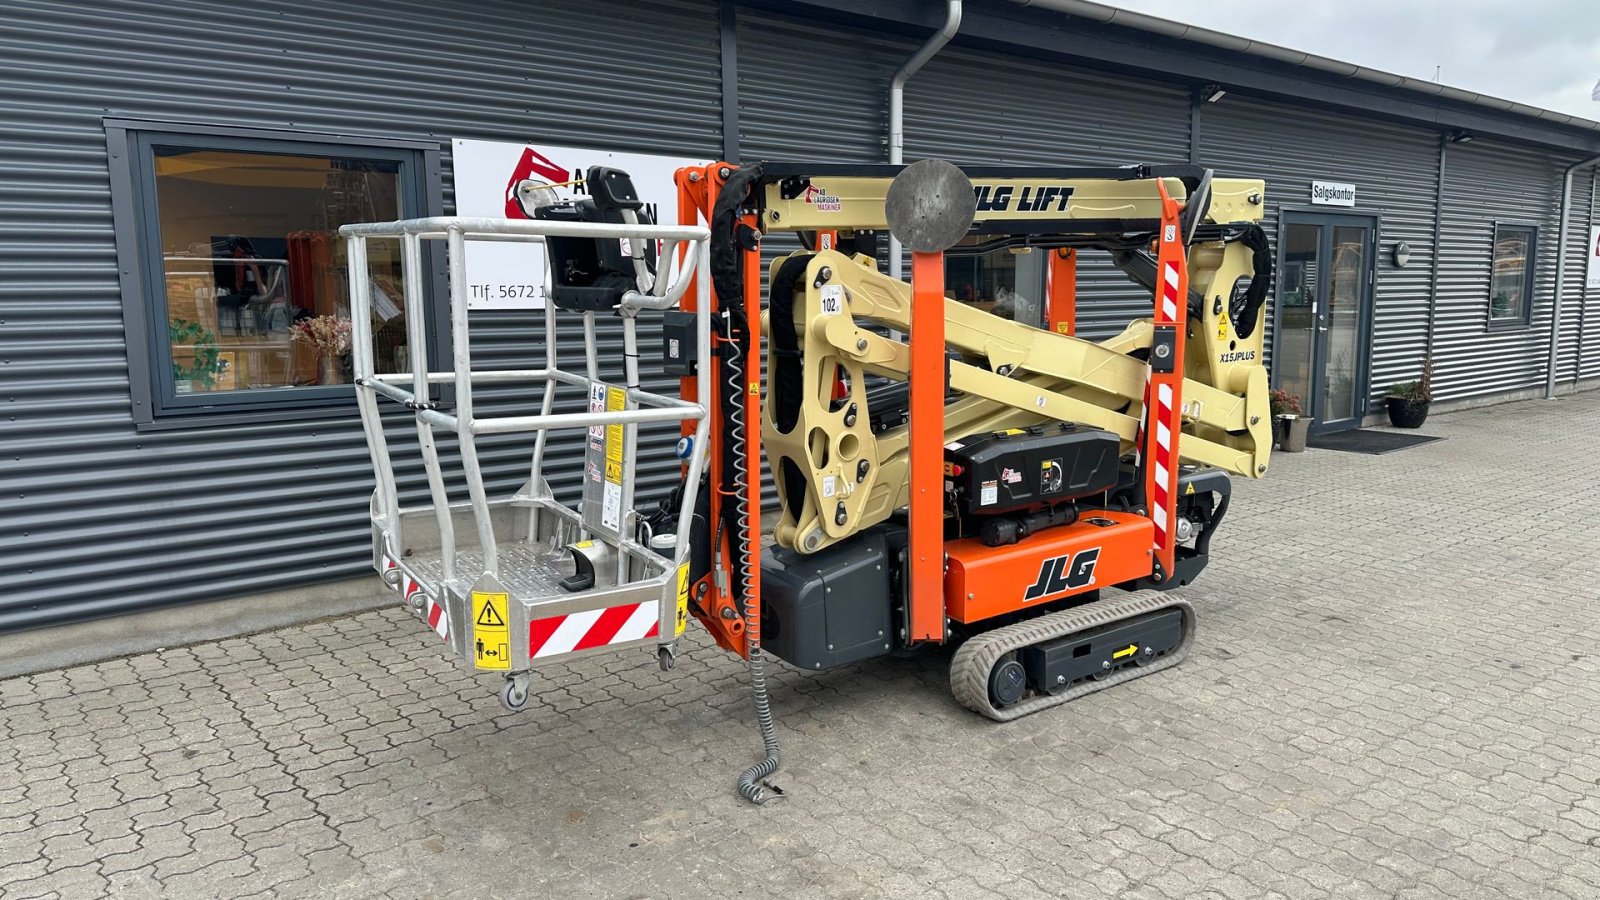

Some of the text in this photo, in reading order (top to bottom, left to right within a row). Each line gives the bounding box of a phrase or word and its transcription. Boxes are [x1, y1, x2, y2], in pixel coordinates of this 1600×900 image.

[1016, 186, 1075, 212] LIFT
[1313, 184, 1354, 202] Salgskontor
[817, 203, 841, 211] MASKINER
[470, 284, 494, 302] Tlf.
[499, 284, 535, 299] 5672
[822, 297, 836, 312] 102
[1219, 350, 1256, 364] X15JPLUS
[1023, 547, 1102, 602] JLG
